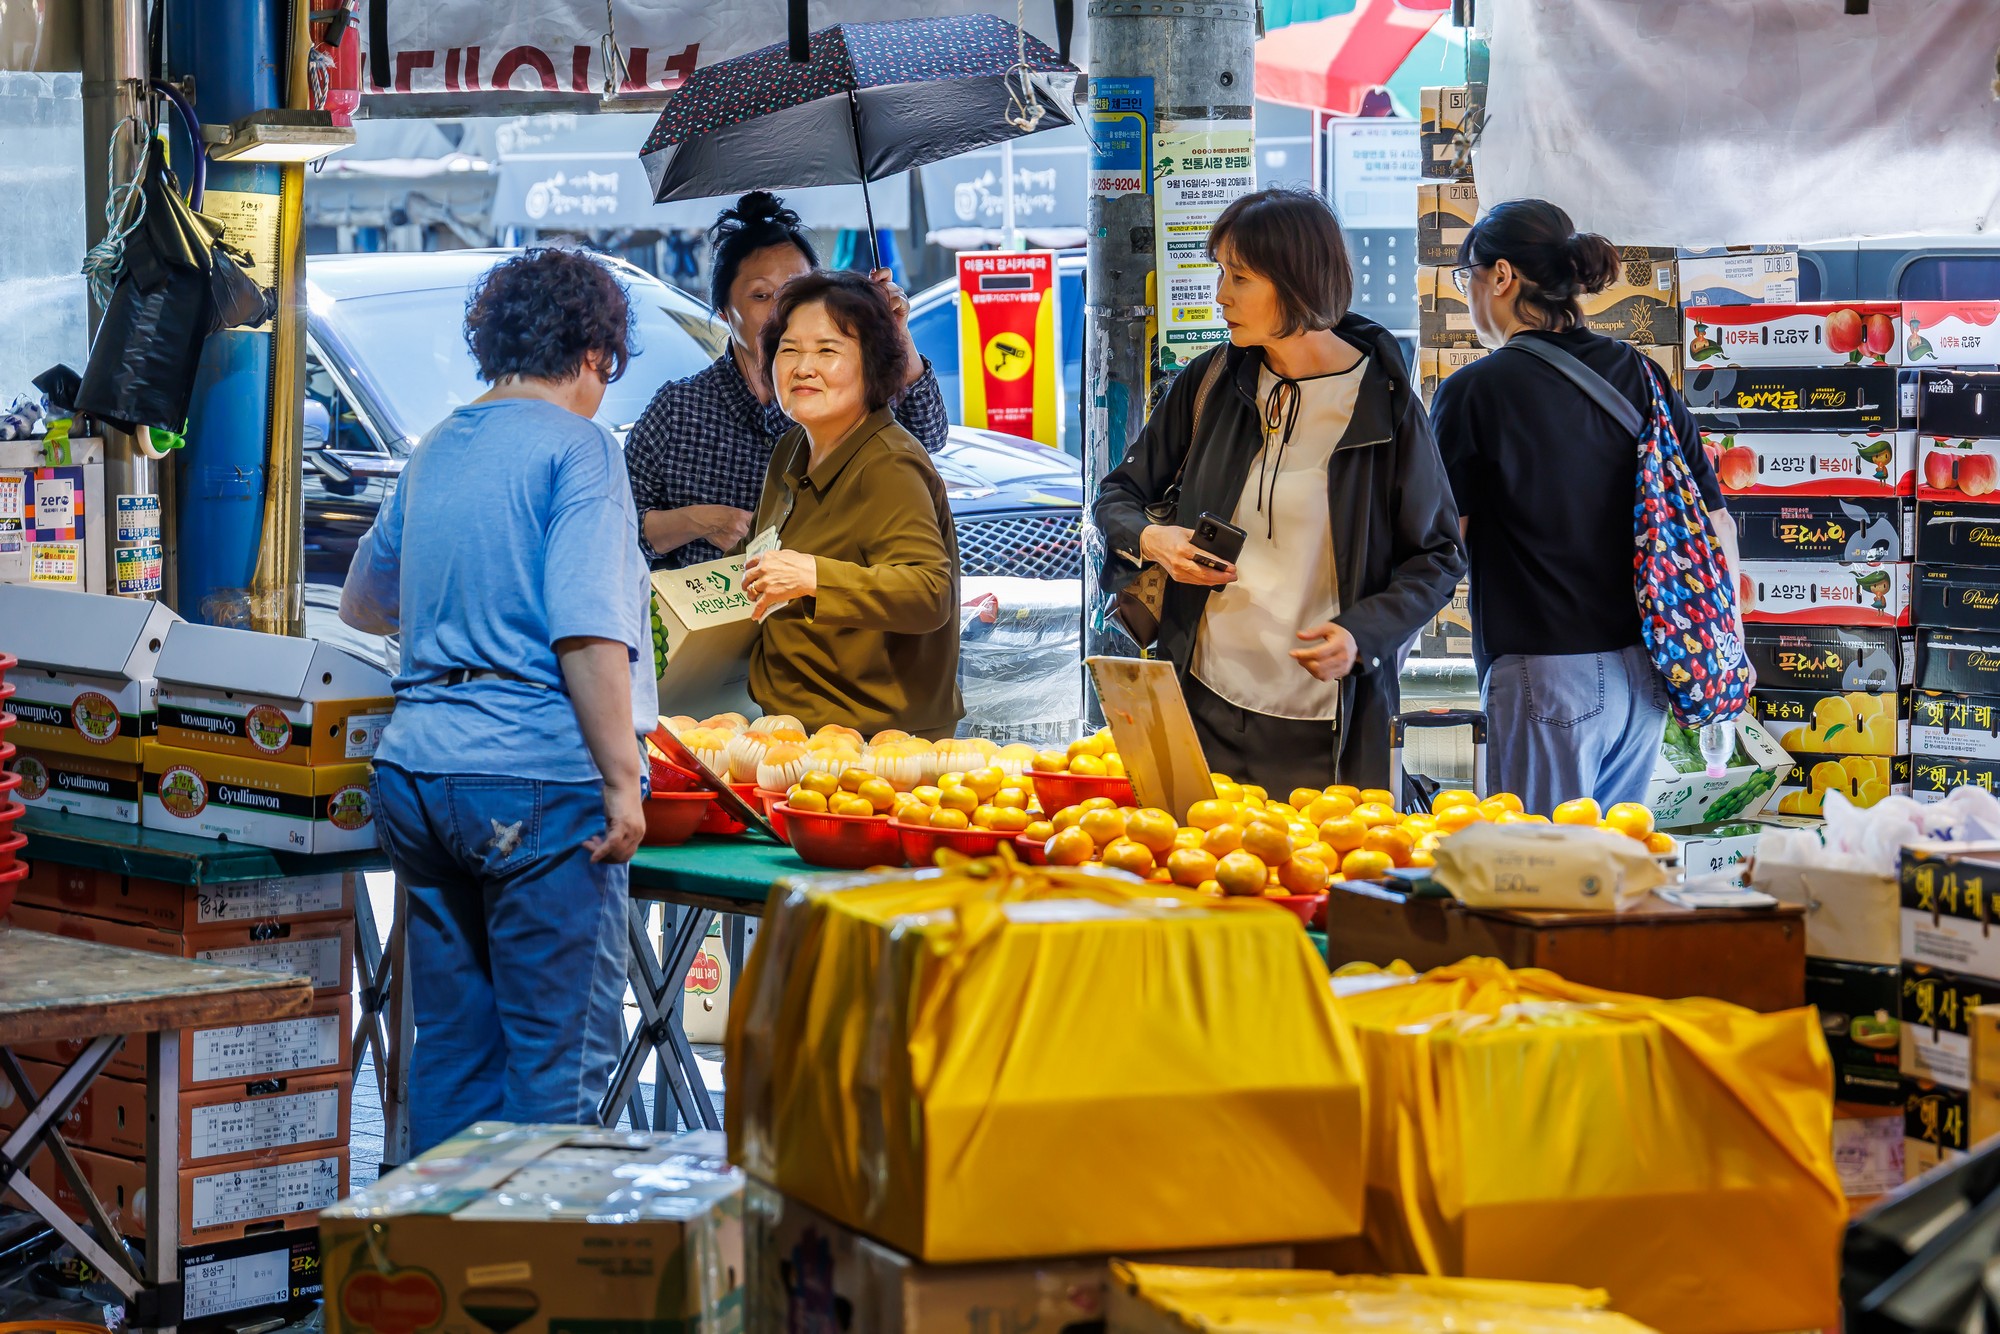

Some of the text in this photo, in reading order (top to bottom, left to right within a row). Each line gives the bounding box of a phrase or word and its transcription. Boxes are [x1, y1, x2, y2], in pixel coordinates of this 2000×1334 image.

[1112, 97, 1142, 110] 체크인
[1453, 95, 1459, 106] 5
[1182, 156, 1222, 170] 전통시장
[1167, 180, 1180, 189] 9월
[1182, 179, 1210, 188] 16일(수)
[1216, 178, 1227, 187] 9월
[1181, 189, 1224, 199] 환급소 운영시간
[1766, 260, 1771, 270] 7
[1172, 292, 1196, 300] 본인확인
[1588, 320, 1626, 331] Pineapple
[1201, 331, 1231, 339] 6956-22
[1725, 329, 1810, 345] 소양강 복숭아
[1940, 336, 1981, 348] 소양강 복숭아
[1809, 390, 1846, 407] Peach
[1770, 457, 1853, 472] 소양강 복숭아
[1969, 526, 2000, 543] Peac
[1771, 585, 1854, 600] 소양강 복숭아
[1962, 588, 2000, 605] Peach
[5, 702, 62, 724] Gyullimwon
[1766, 703, 1805, 718] 복숭아
[1927, 703, 1991, 729] 햇사레
[181, 713, 235, 734] Gyullimwon
[58, 772, 110, 792] Gyullimwon
[1930, 767, 1992, 793] 햇사레
[218, 786, 280, 809] Gyullimwon
[289, 830, 305, 845] 5kg
[1916, 866, 1983, 917] 햇사레
[704, 968, 718, 981] Del
[1921, 1098, 1962, 1147] 햇사
[201, 1264, 225, 1278] 정성구
[276, 1289, 287, 1300] 13
